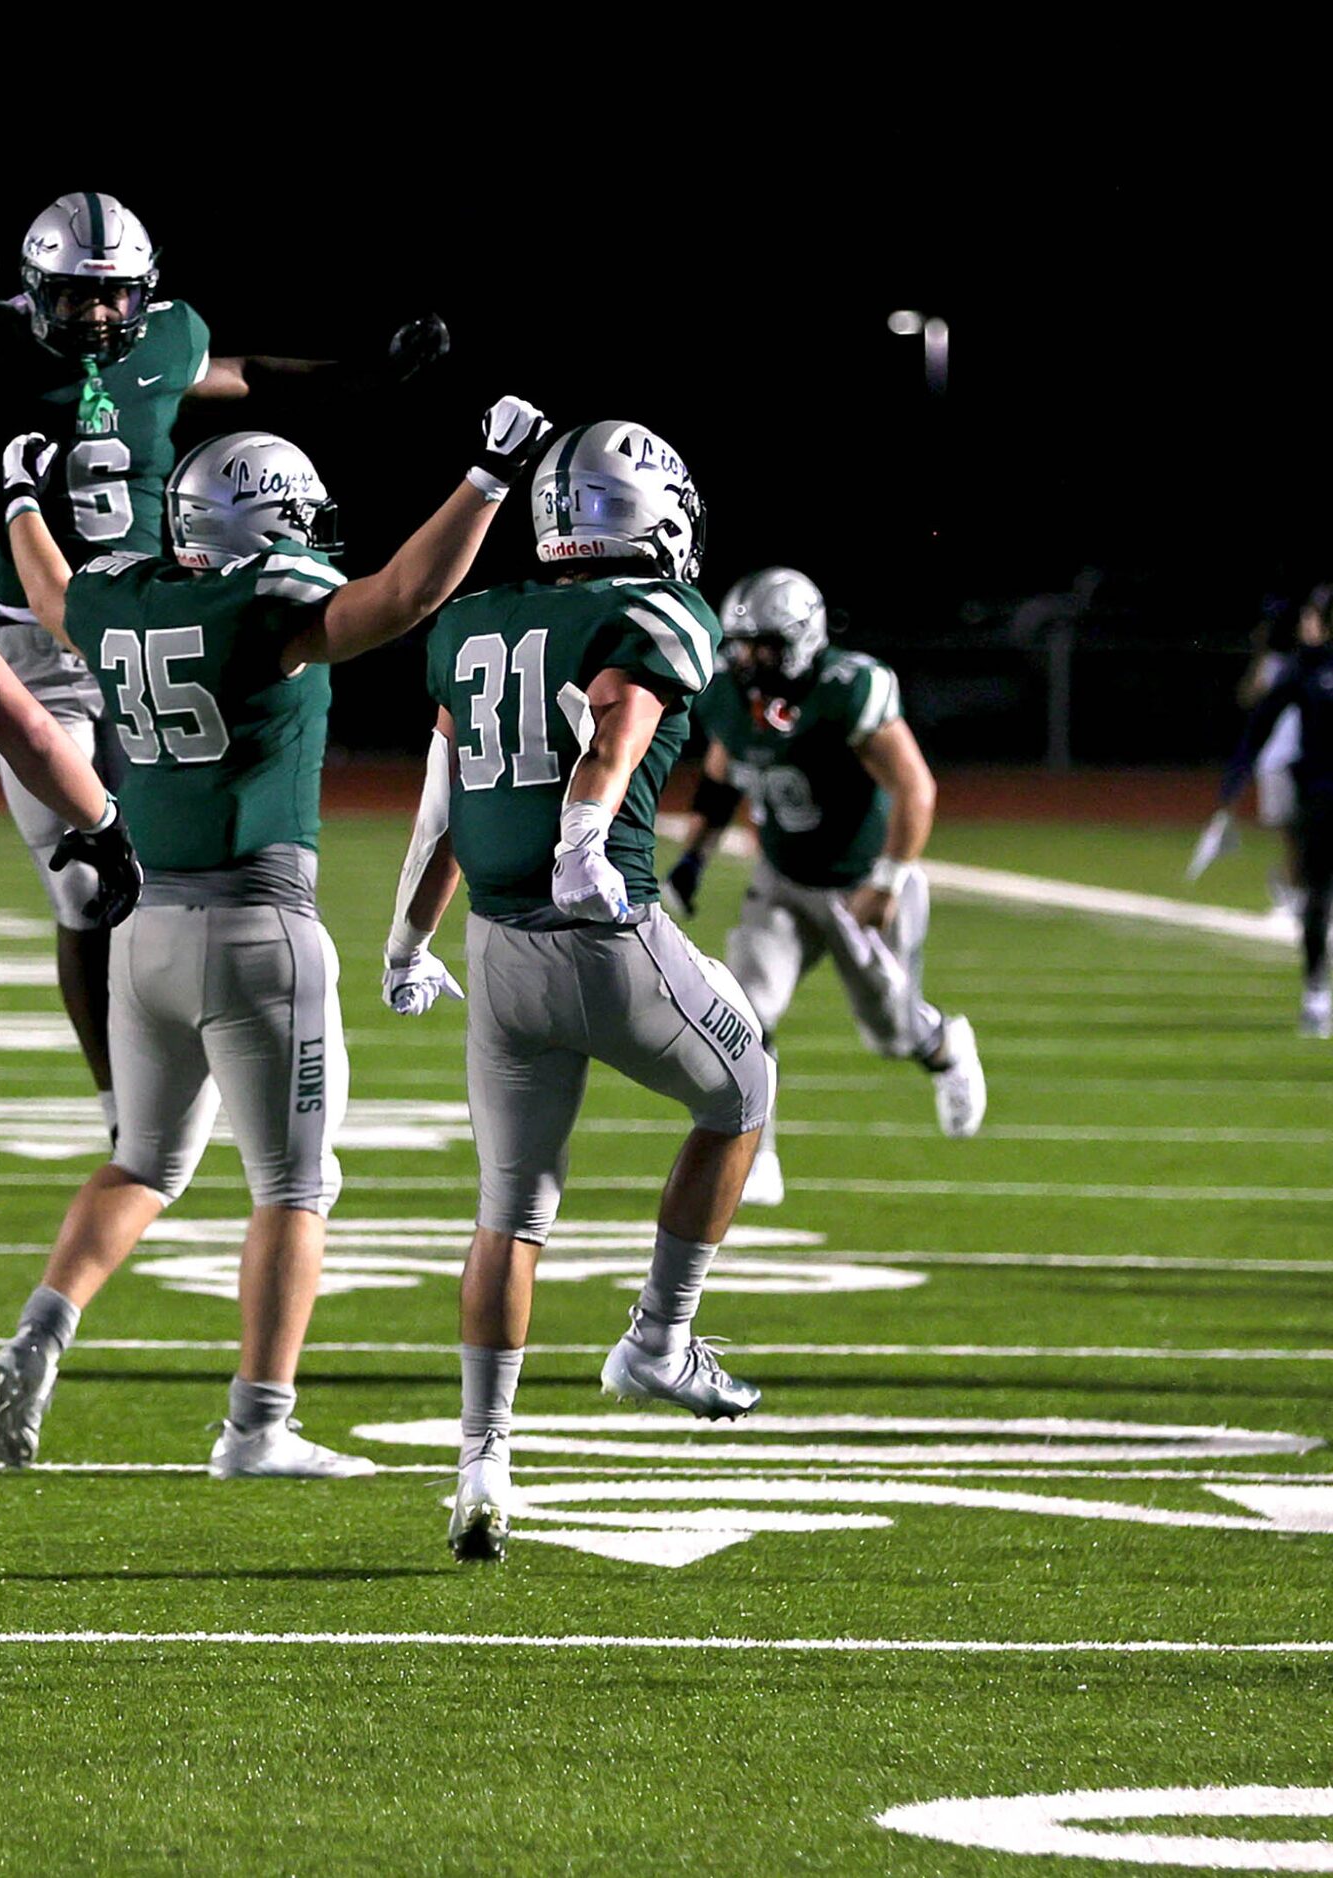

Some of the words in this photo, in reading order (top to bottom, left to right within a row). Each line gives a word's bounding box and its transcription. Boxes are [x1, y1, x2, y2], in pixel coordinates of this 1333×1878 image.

[67, 437, 134, 541] 6
[100, 625, 230, 764] 35
[454, 628, 561, 791] 31
[296, 1036, 324, 1113] LIONS
[699, 997, 752, 1062] LIONS
